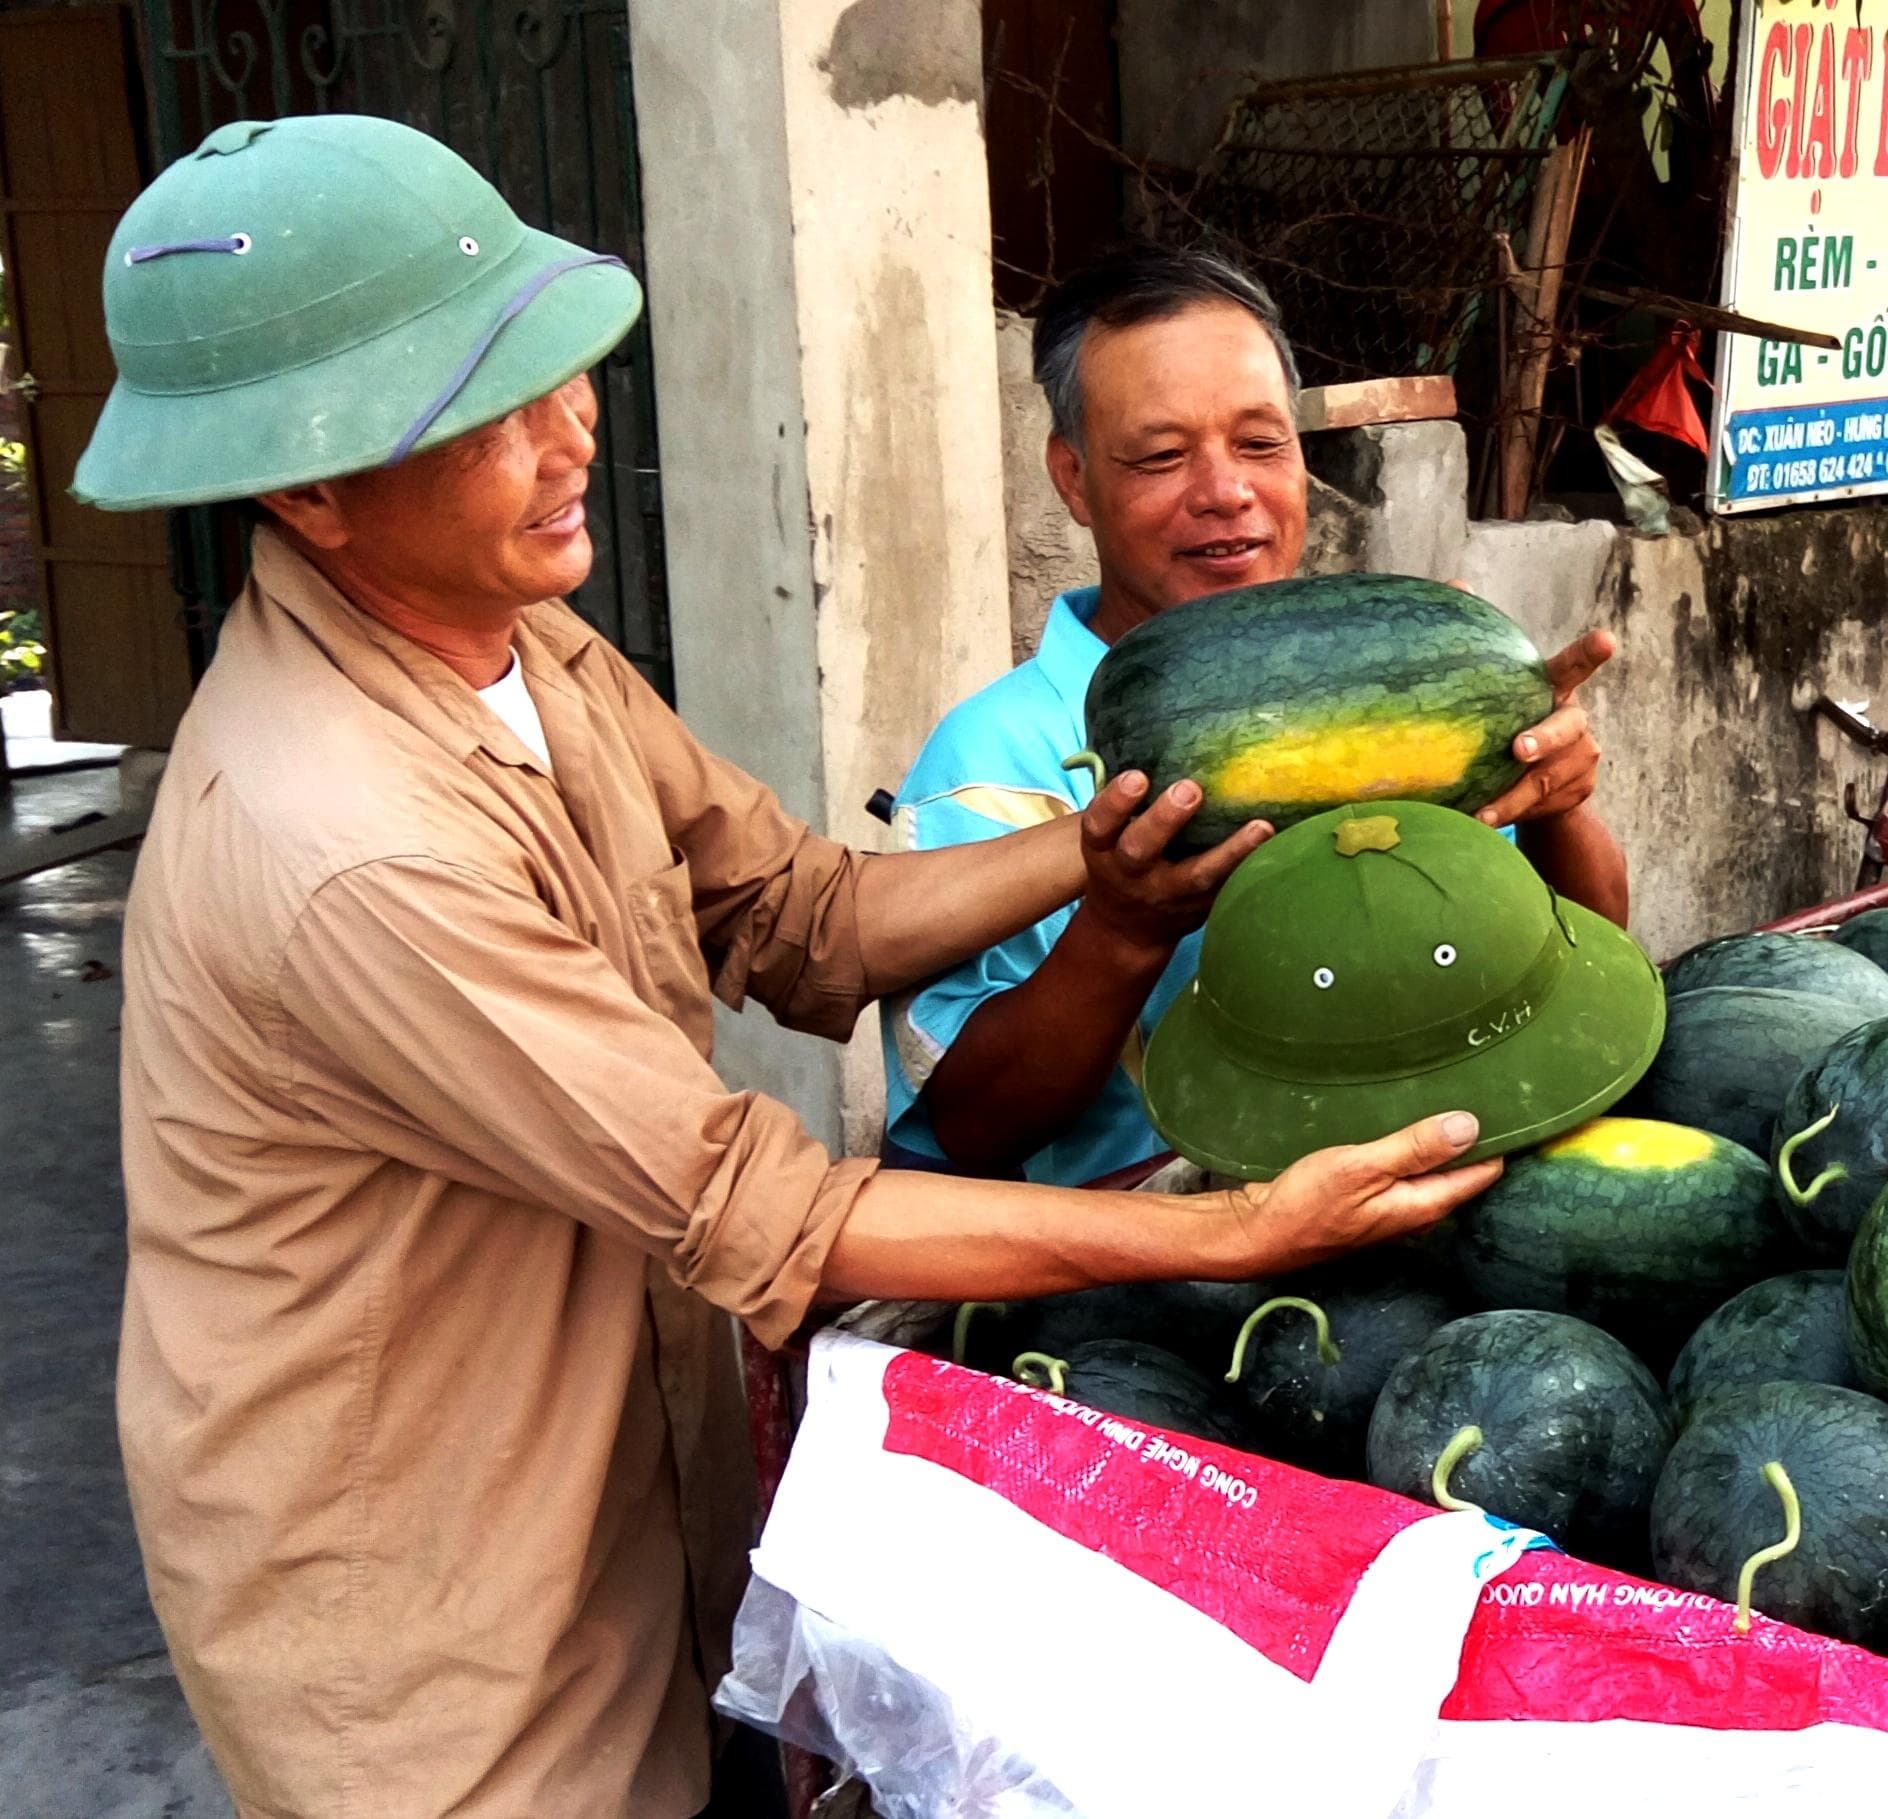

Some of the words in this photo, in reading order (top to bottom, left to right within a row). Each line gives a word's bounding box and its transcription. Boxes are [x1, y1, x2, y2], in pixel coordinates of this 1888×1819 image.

[1773, 223, 1854, 291] RÈM
[1763, 416, 1805, 452] XUÂN
[1818, 455, 1845, 484] 624
[1847, 452, 1873, 479] 424
[1139, 1432, 1202, 1481] NGHỆ
[1200, 1462, 1258, 1508] CÔNG
[1549, 1583, 1608, 1614] HÀN
